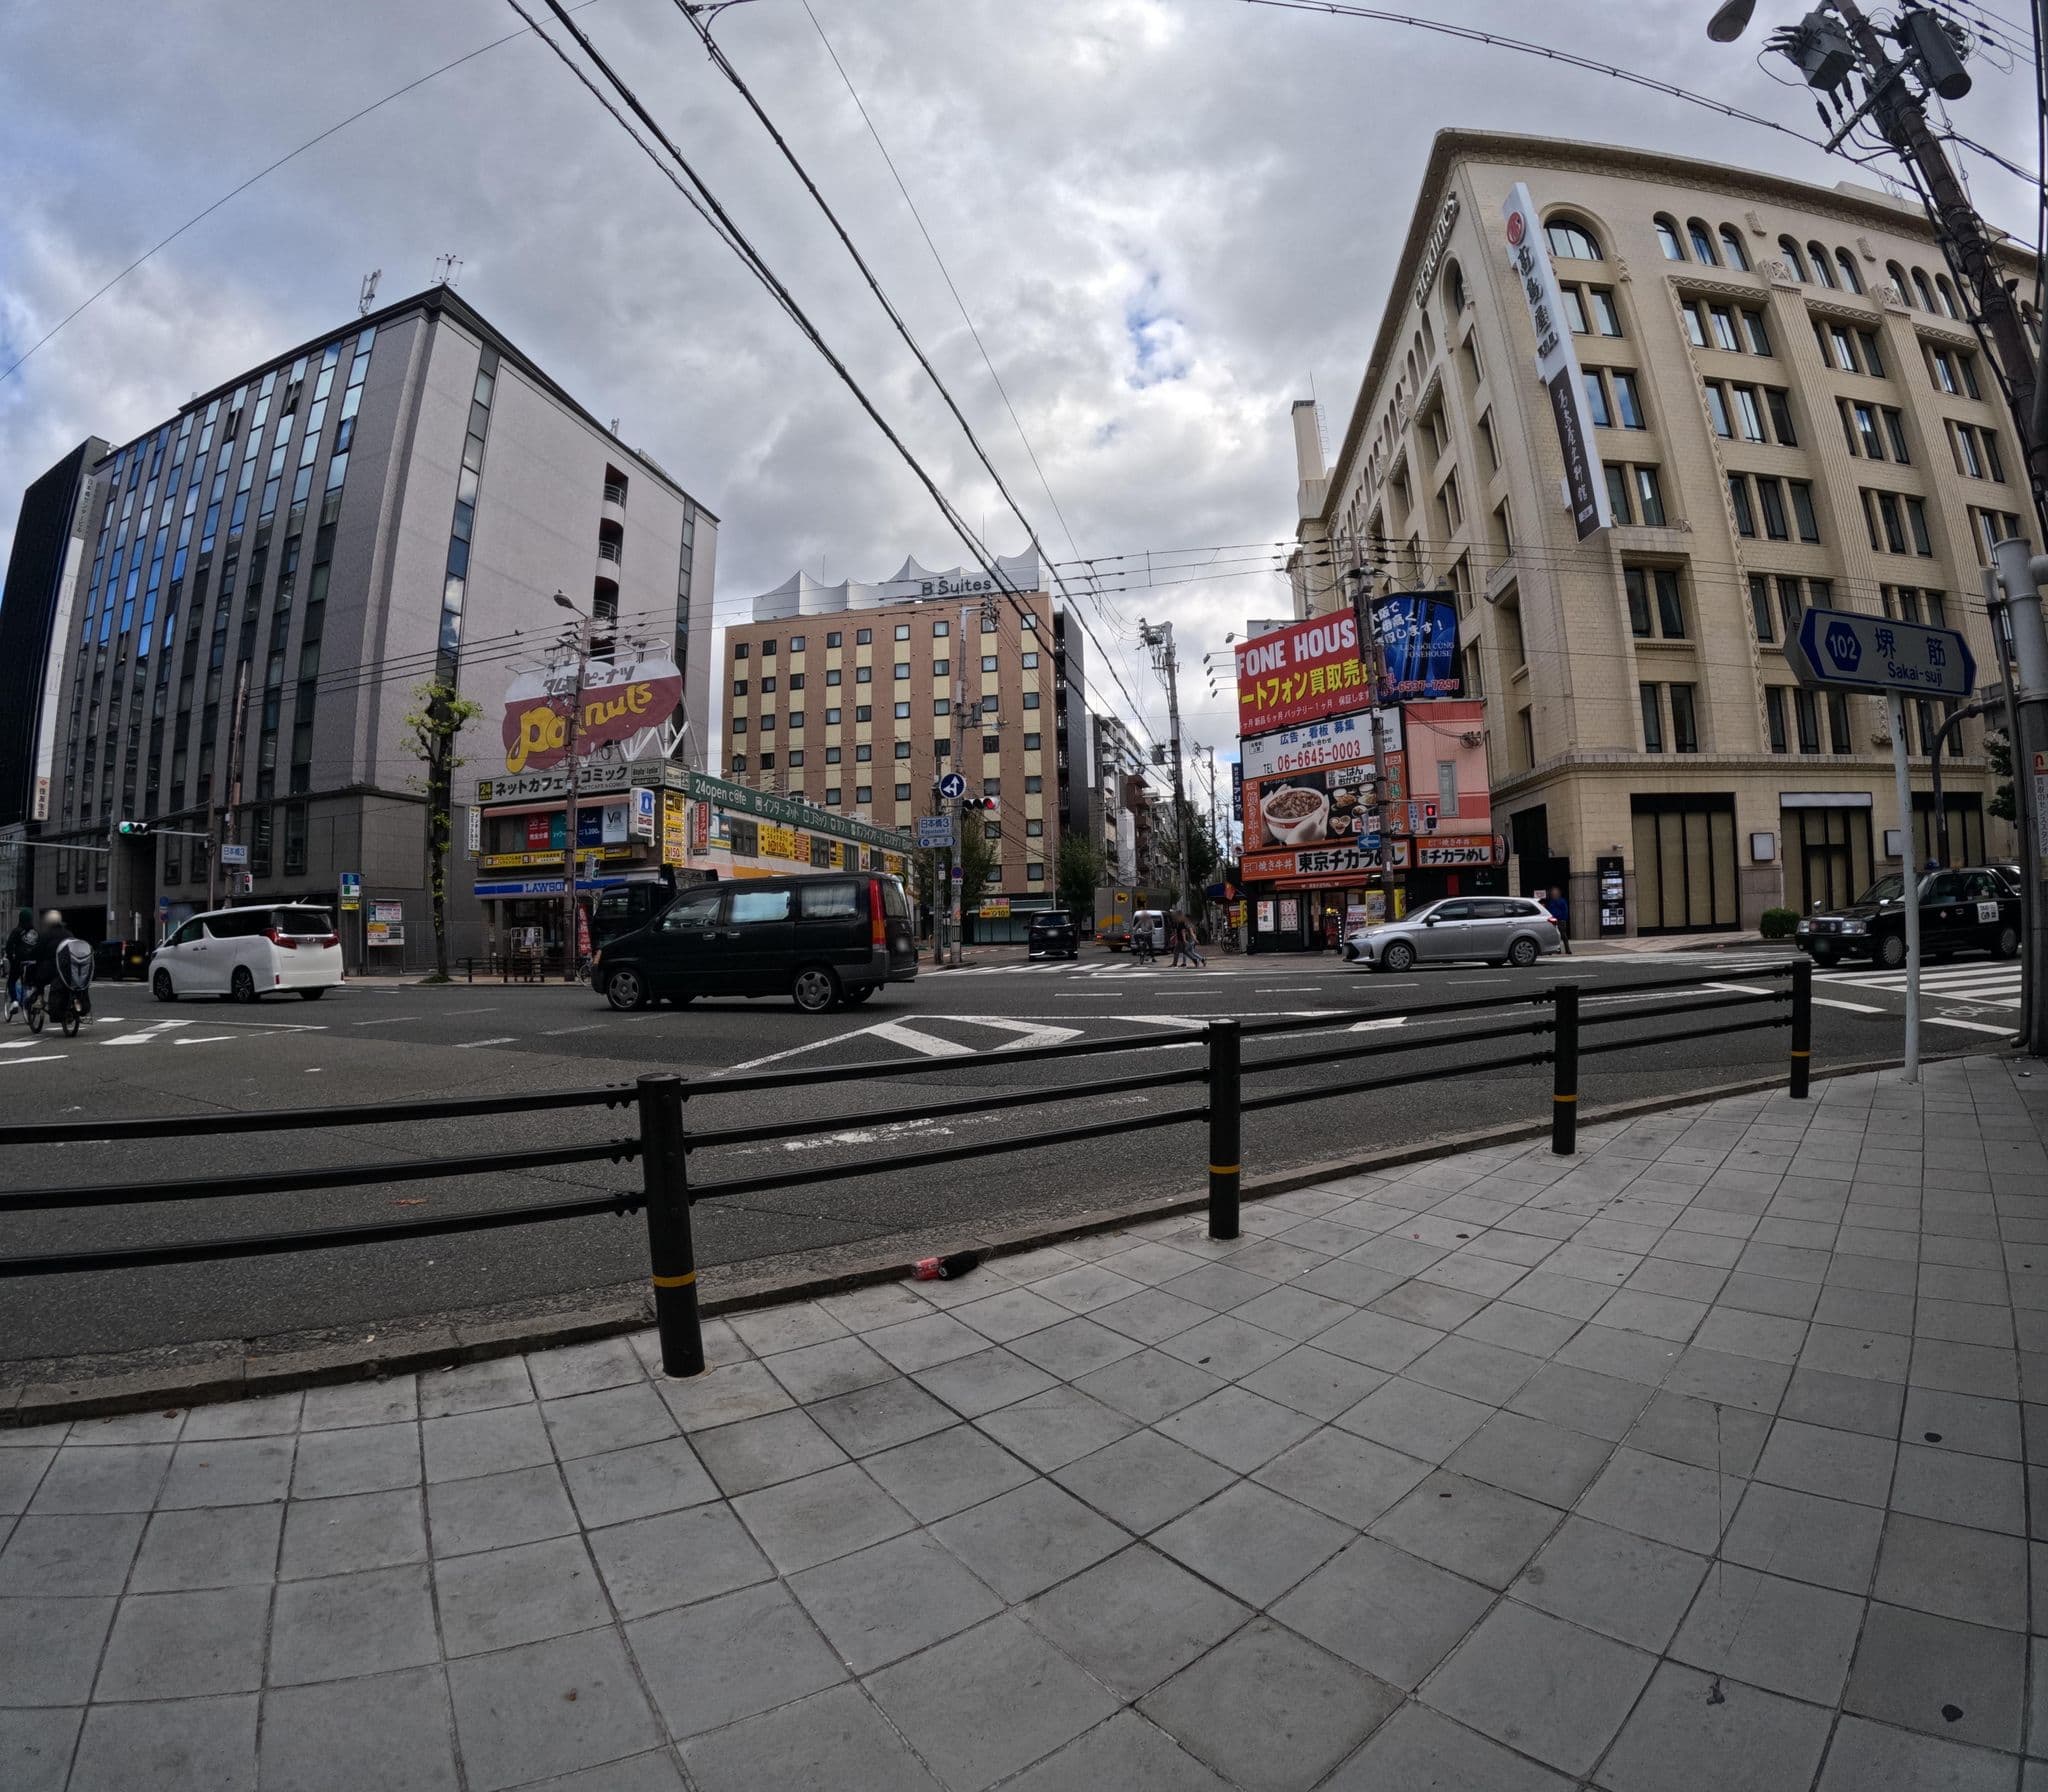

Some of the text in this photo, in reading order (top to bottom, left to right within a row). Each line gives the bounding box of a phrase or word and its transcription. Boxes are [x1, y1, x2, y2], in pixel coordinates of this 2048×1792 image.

[922, 579, 992, 596] B Suites
[1294, 618, 1359, 662] HOUS
[1829, 634, 1858, 661] 102
[1238, 658, 1377, 711] ートフォン買取売
[1888, 661, 1943, 687] Sakai-suji
[1263, 762, 1274, 775] TEL
[1277, 740, 1361, 772] 06-6645-0003
[920, 817, 950, 829] 日本橋3
[1429, 848, 1489, 863] チカラめし
[524, 881, 566, 893] LAWSO
